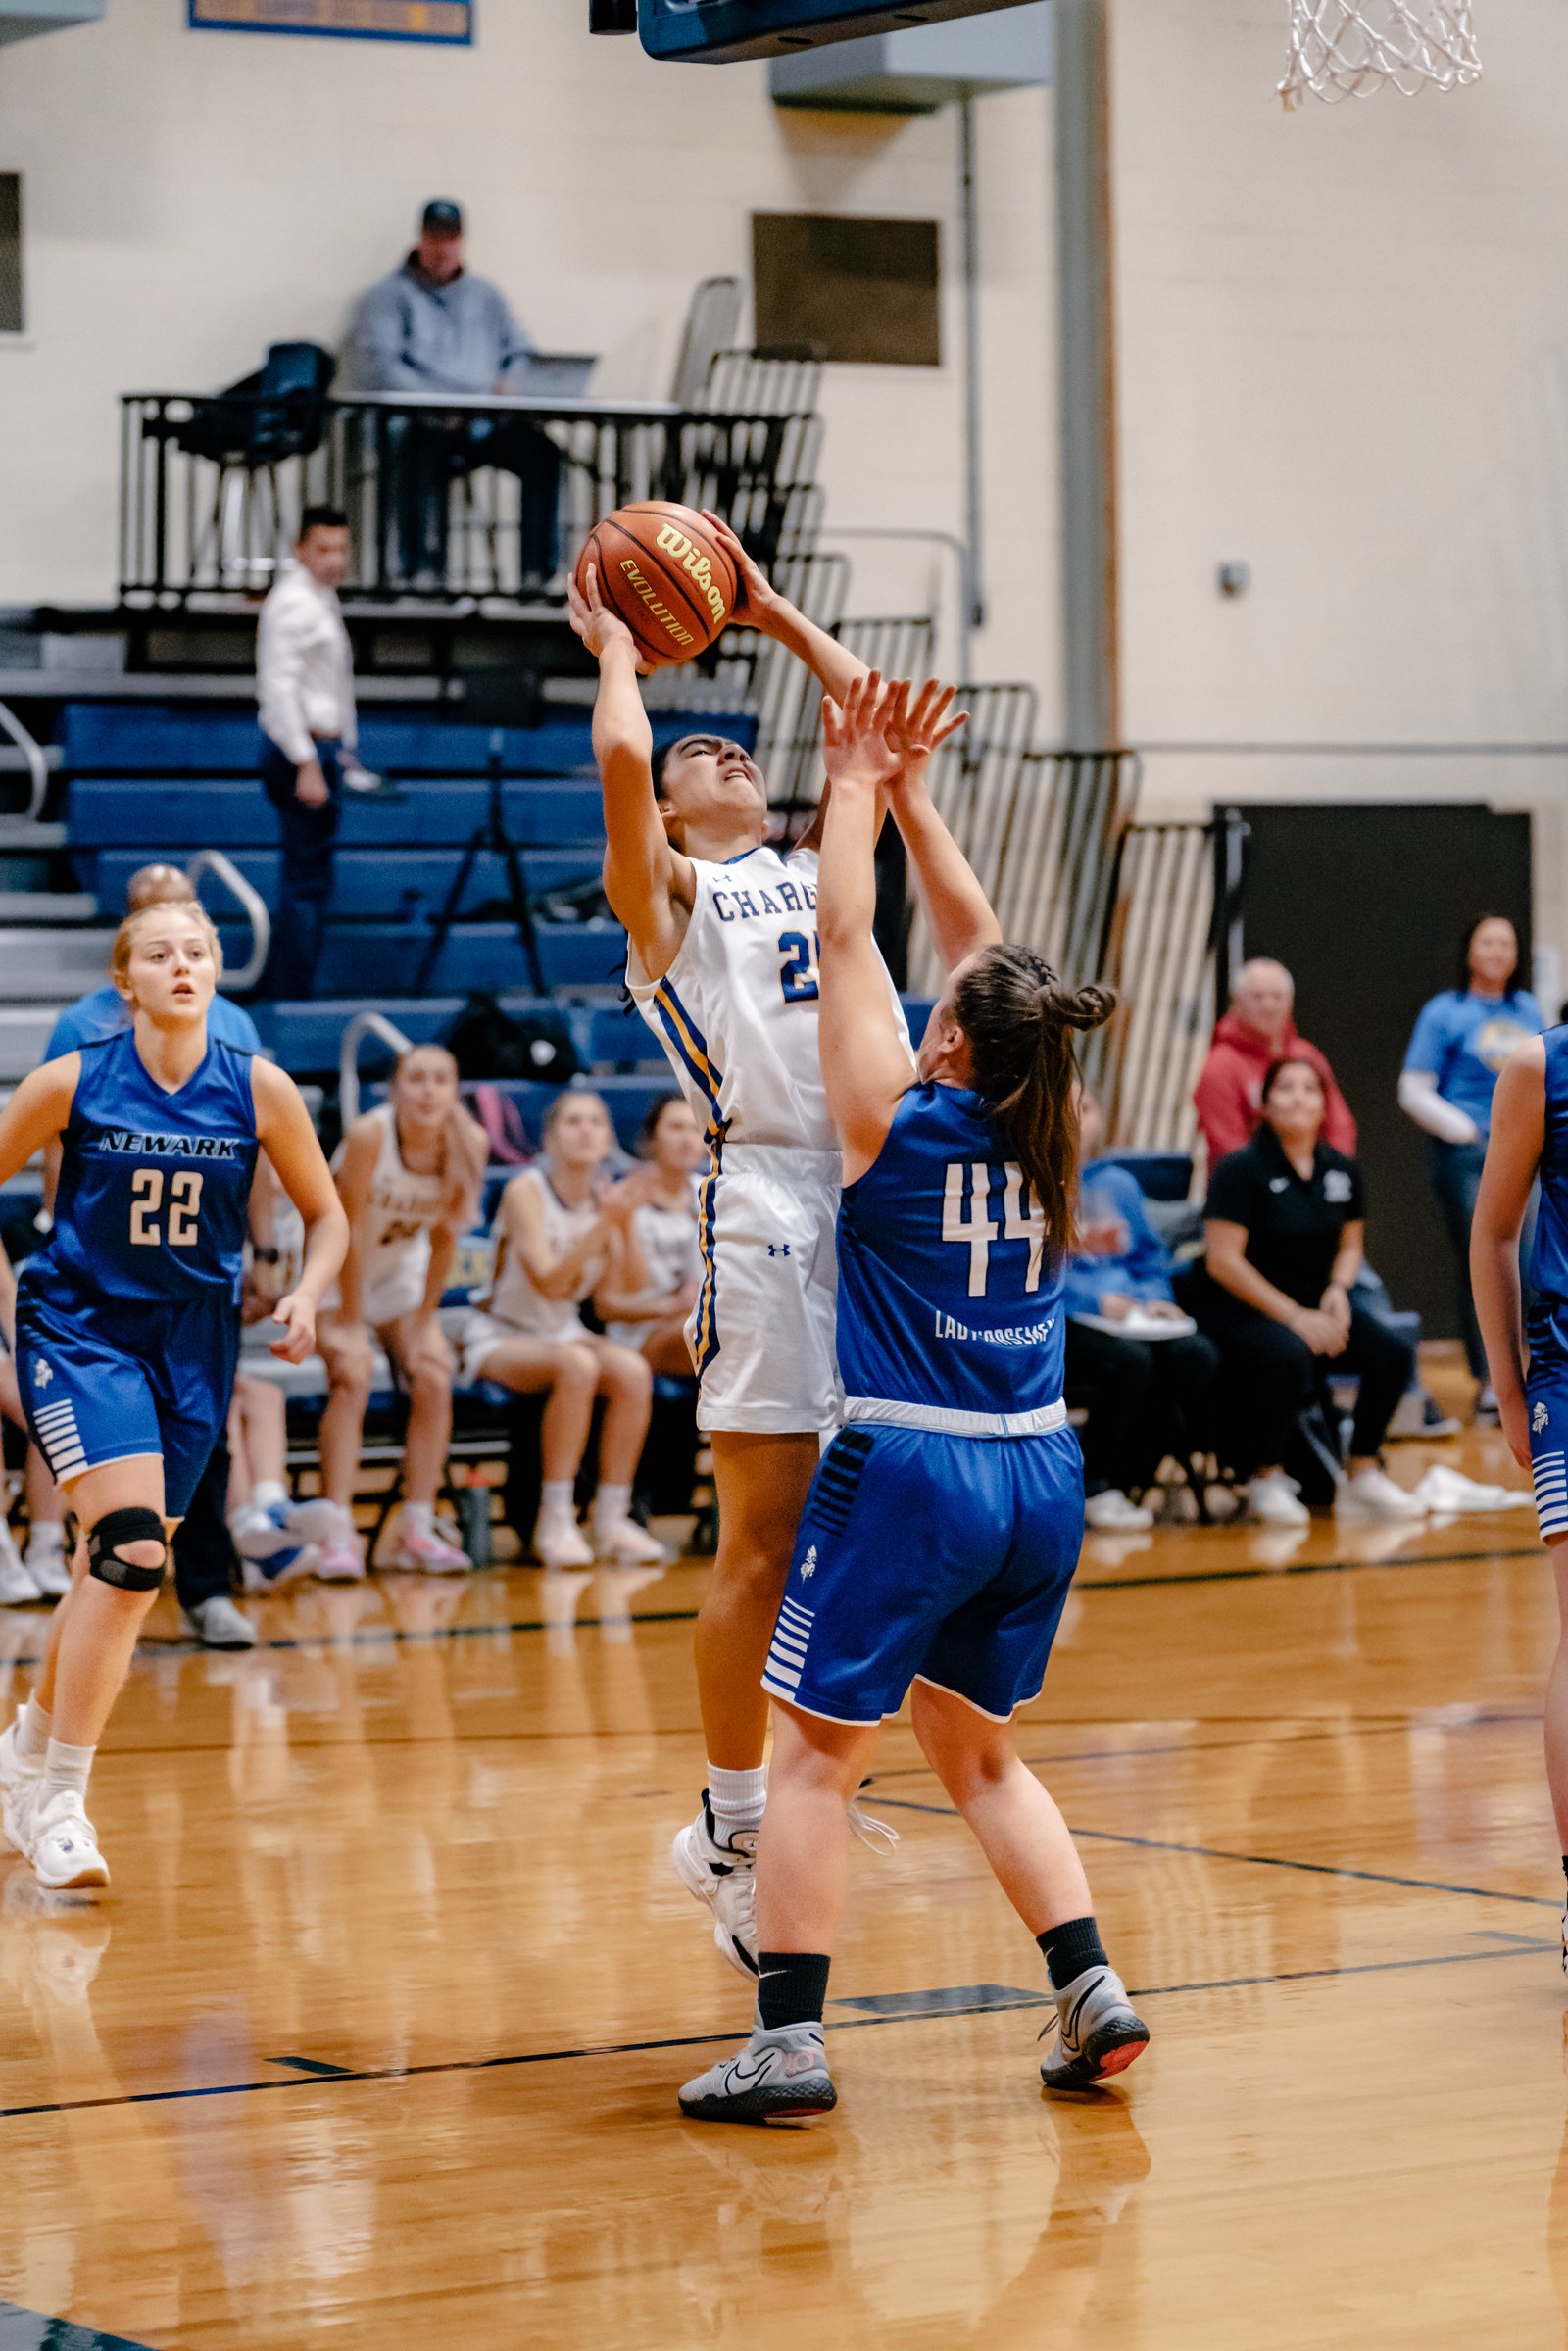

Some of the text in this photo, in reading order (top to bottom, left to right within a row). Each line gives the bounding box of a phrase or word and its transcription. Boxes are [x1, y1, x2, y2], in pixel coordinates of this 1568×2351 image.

[619, 559, 694, 646] EVOLUTION
[656, 523, 726, 624] Wilson
[777, 931, 820, 1004] 2
[99, 1130, 240, 1159] NEWARK
[129, 1168, 204, 1247] 22
[942, 1161, 1050, 1297] 44
